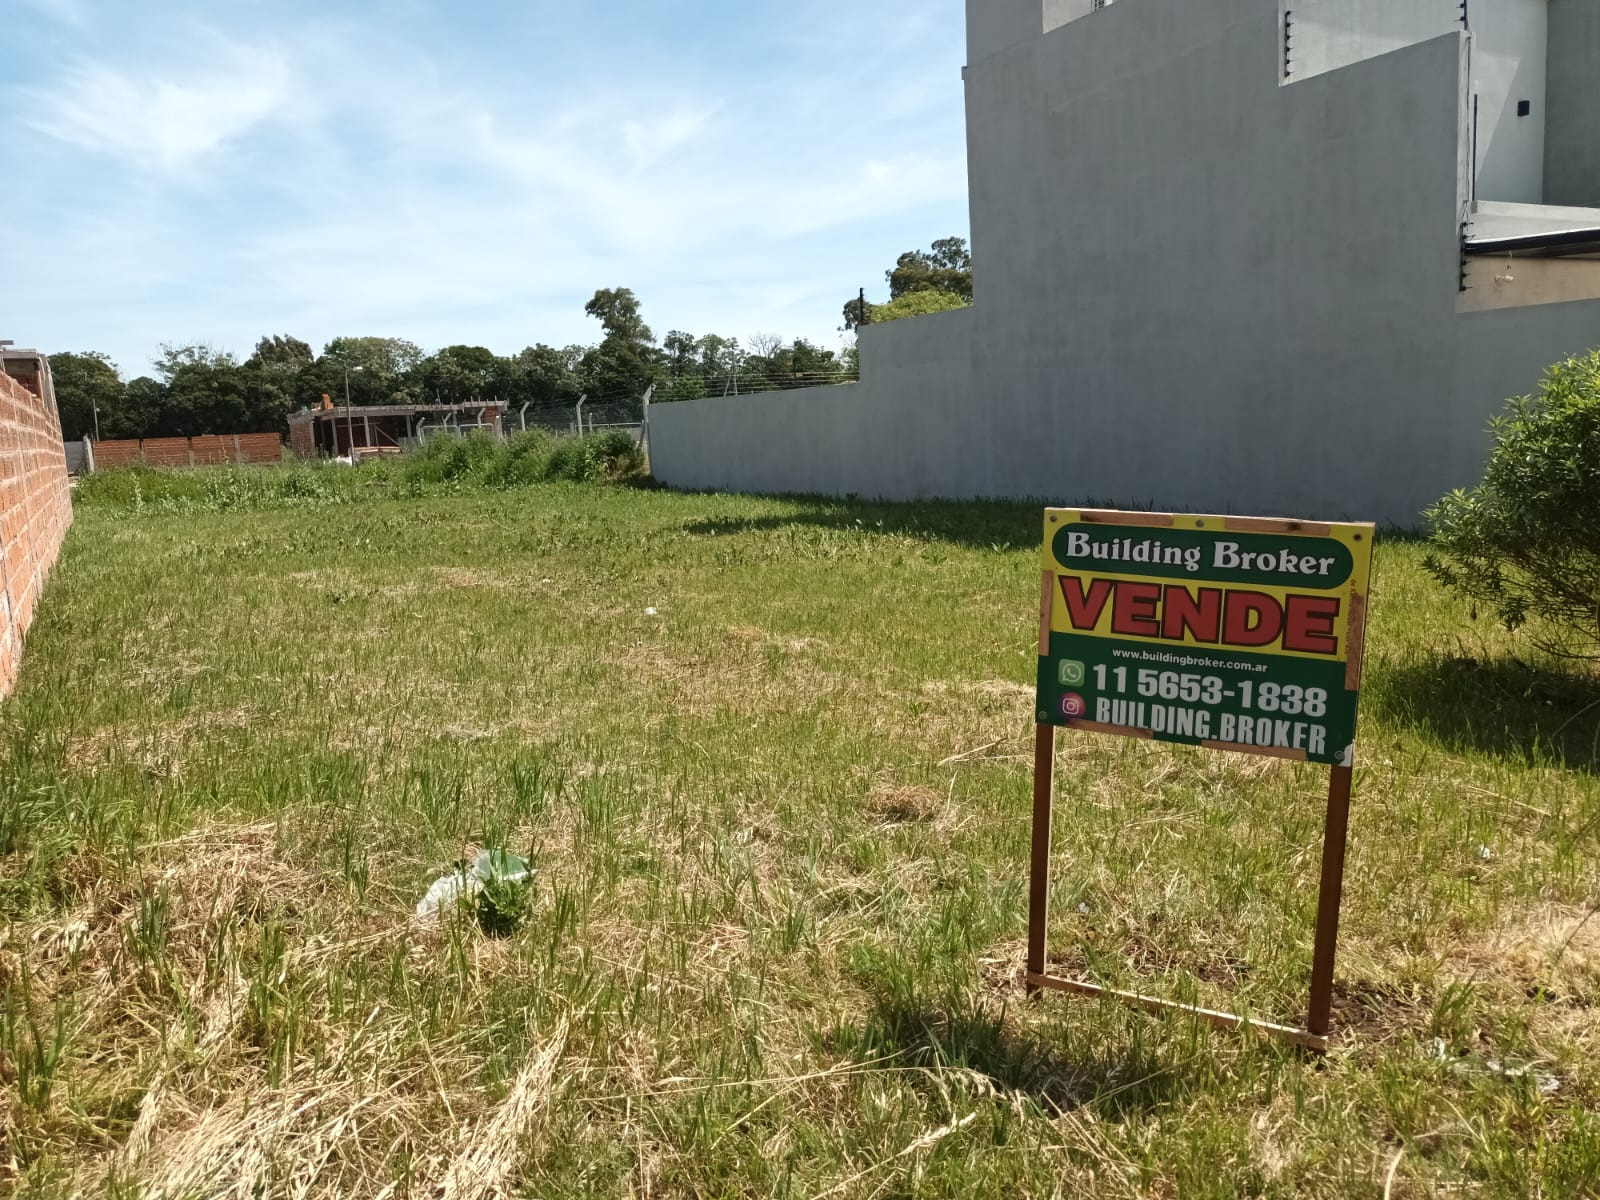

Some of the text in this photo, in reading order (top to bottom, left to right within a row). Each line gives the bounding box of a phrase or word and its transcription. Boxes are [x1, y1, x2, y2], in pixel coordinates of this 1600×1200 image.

[1066, 532, 1335, 575] Building Broker
[1058, 575, 1340, 655] VENDE
[1112, 649, 1268, 672] www.buildingbroker.com.ar
[1093, 664, 1327, 717] 11 5653-1838
[1096, 697, 1326, 755] BUILDING.BROKER
